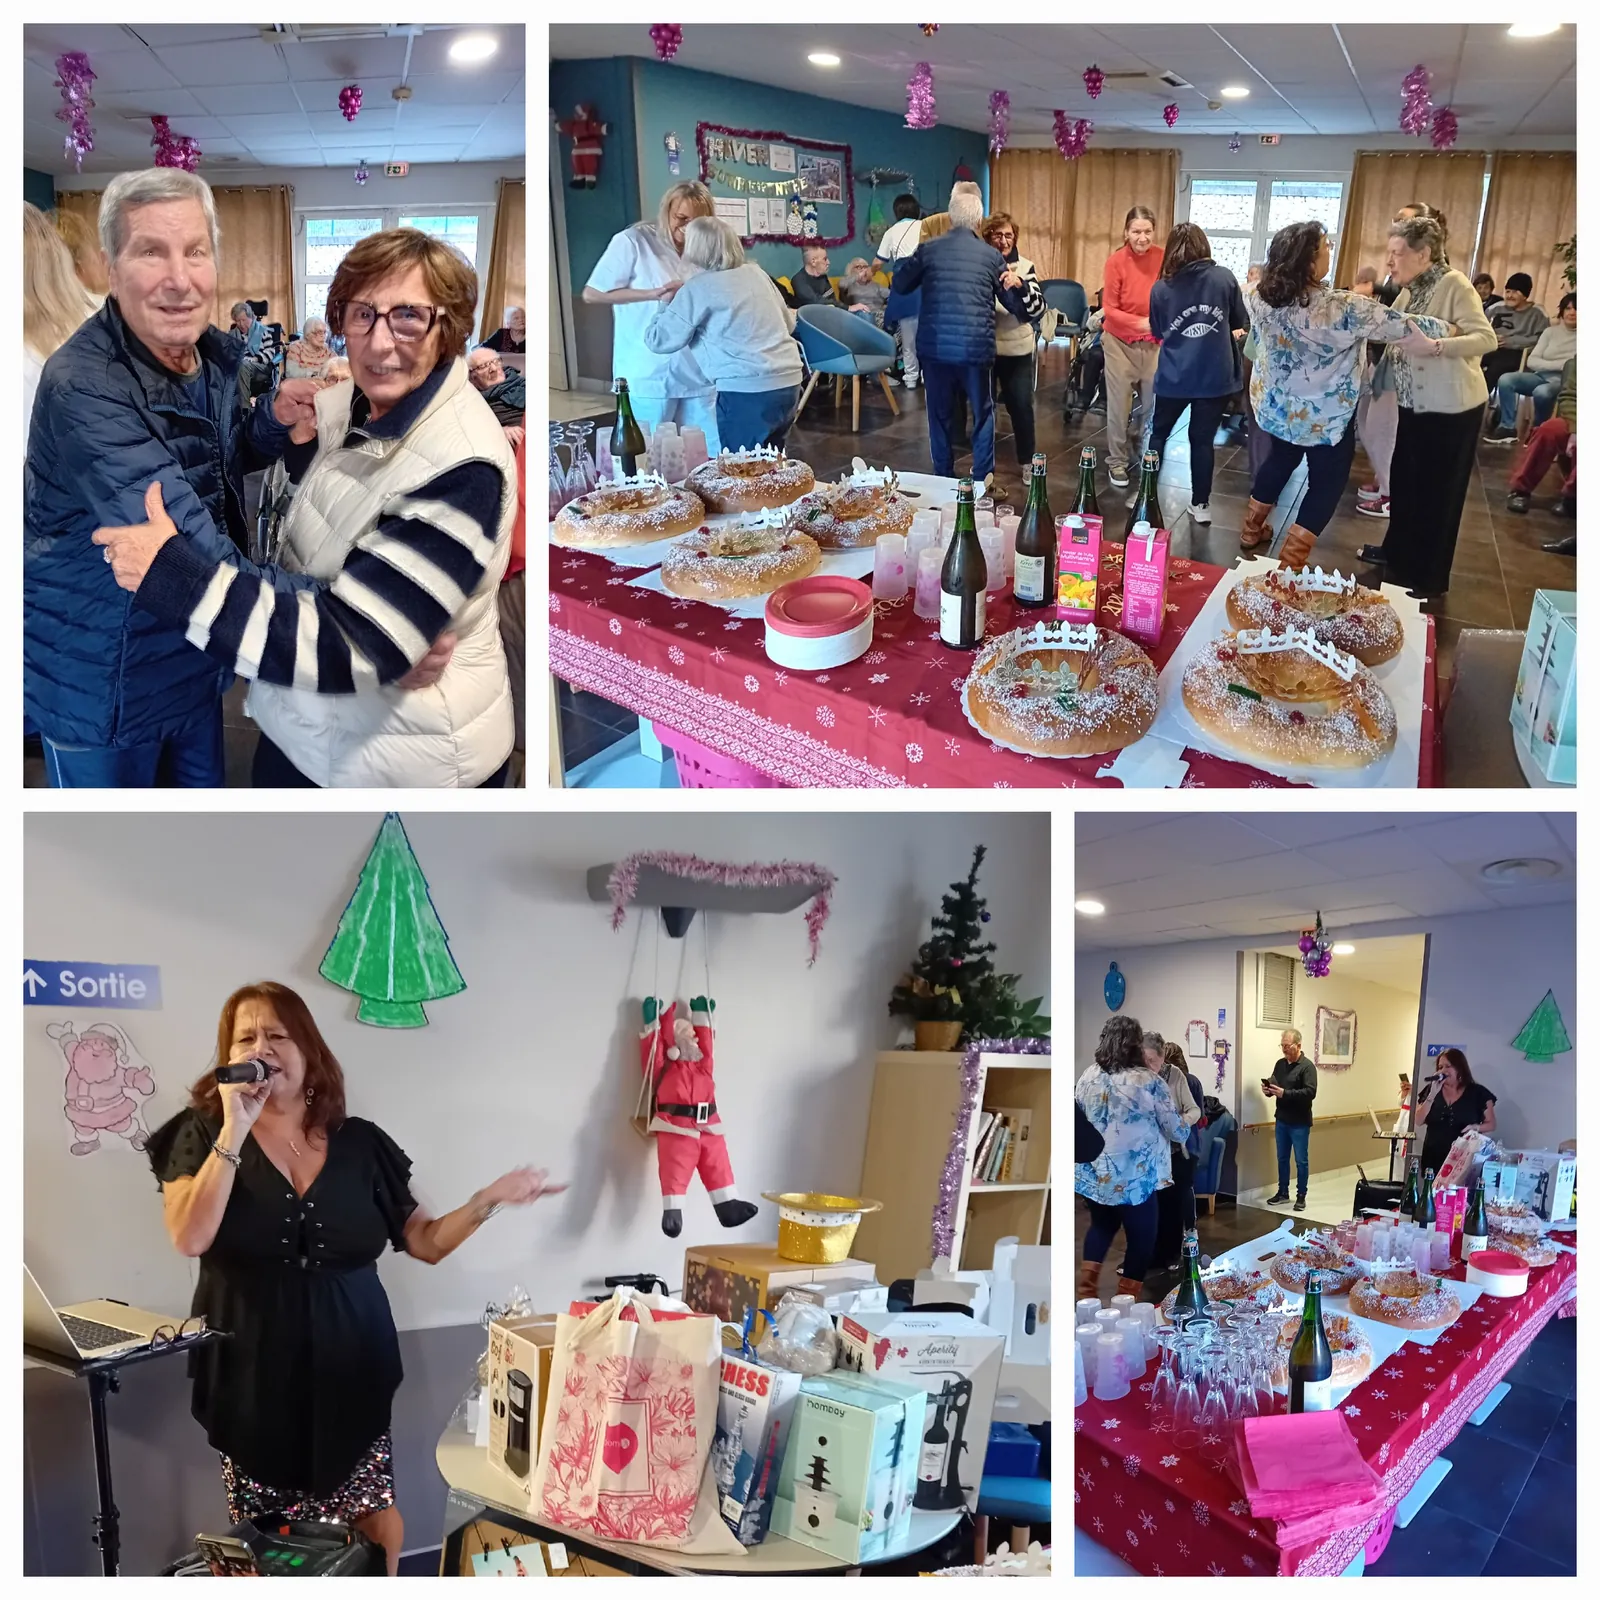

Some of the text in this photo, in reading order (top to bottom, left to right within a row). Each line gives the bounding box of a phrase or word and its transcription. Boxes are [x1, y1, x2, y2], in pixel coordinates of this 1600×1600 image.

[1182, 306, 1197, 318] are
[1199, 304, 1212, 314] my
[1212, 306, 1224, 322] life
[60, 970, 147, 999] Sortie
